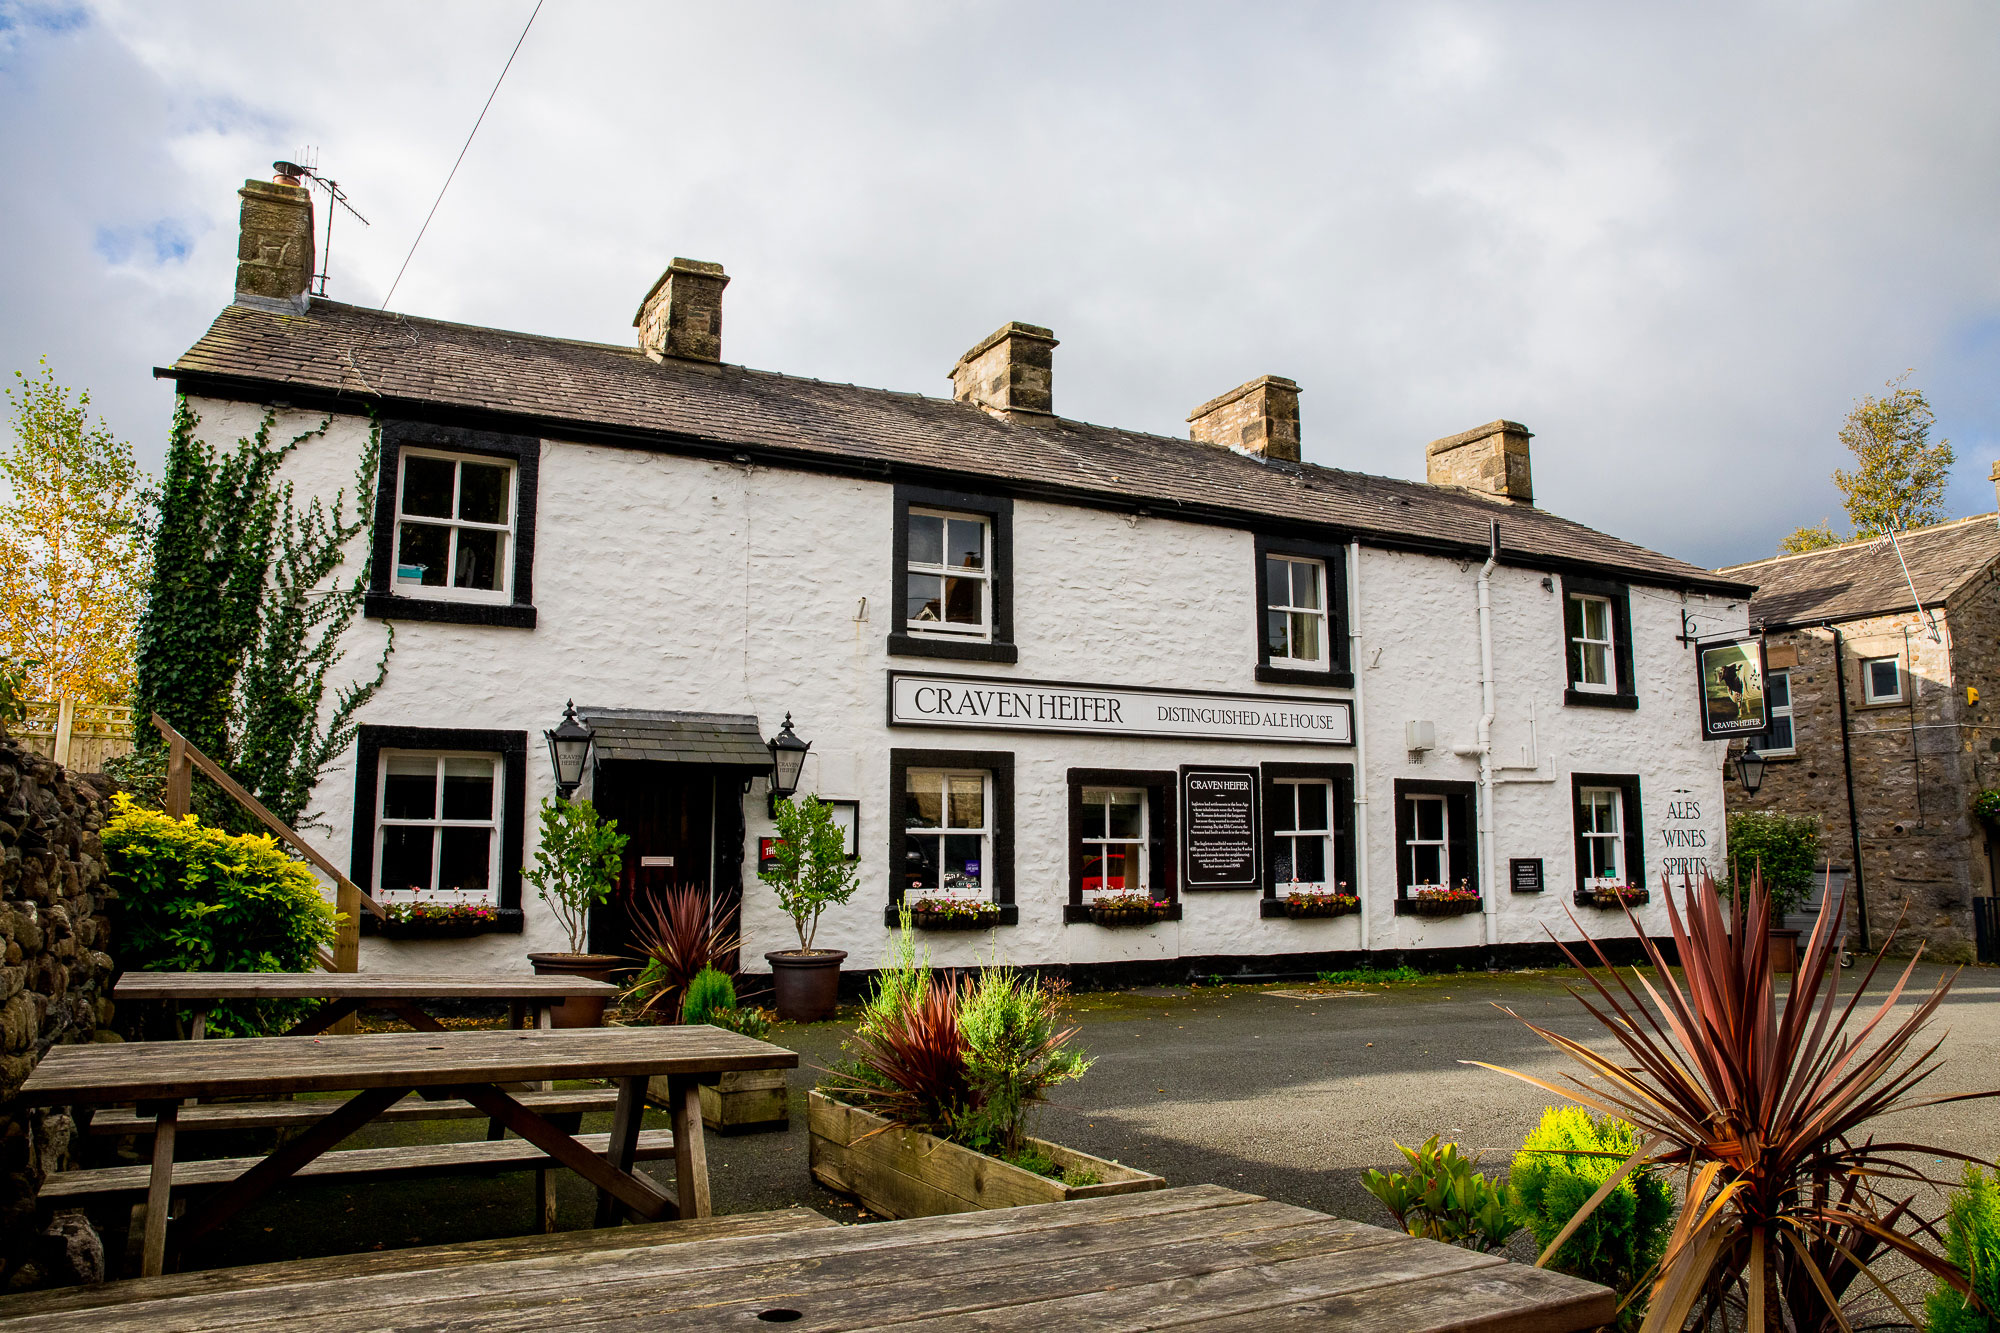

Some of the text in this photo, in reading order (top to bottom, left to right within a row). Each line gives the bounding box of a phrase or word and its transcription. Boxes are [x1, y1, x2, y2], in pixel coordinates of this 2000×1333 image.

[915, 687, 1123, 723] CRAVEN HEIFER
[1157, 706, 1333, 730] DISTINGUISHED ALE HOUSE
[1712, 718, 1761, 729] CRAVEN HEIFER
[1191, 781, 1249, 790] CRAVEN HEIFER
[1667, 801, 1700, 819] ALES
[1662, 829, 1706, 847] WINES
[1663, 857, 1707, 875] SPIRITS
